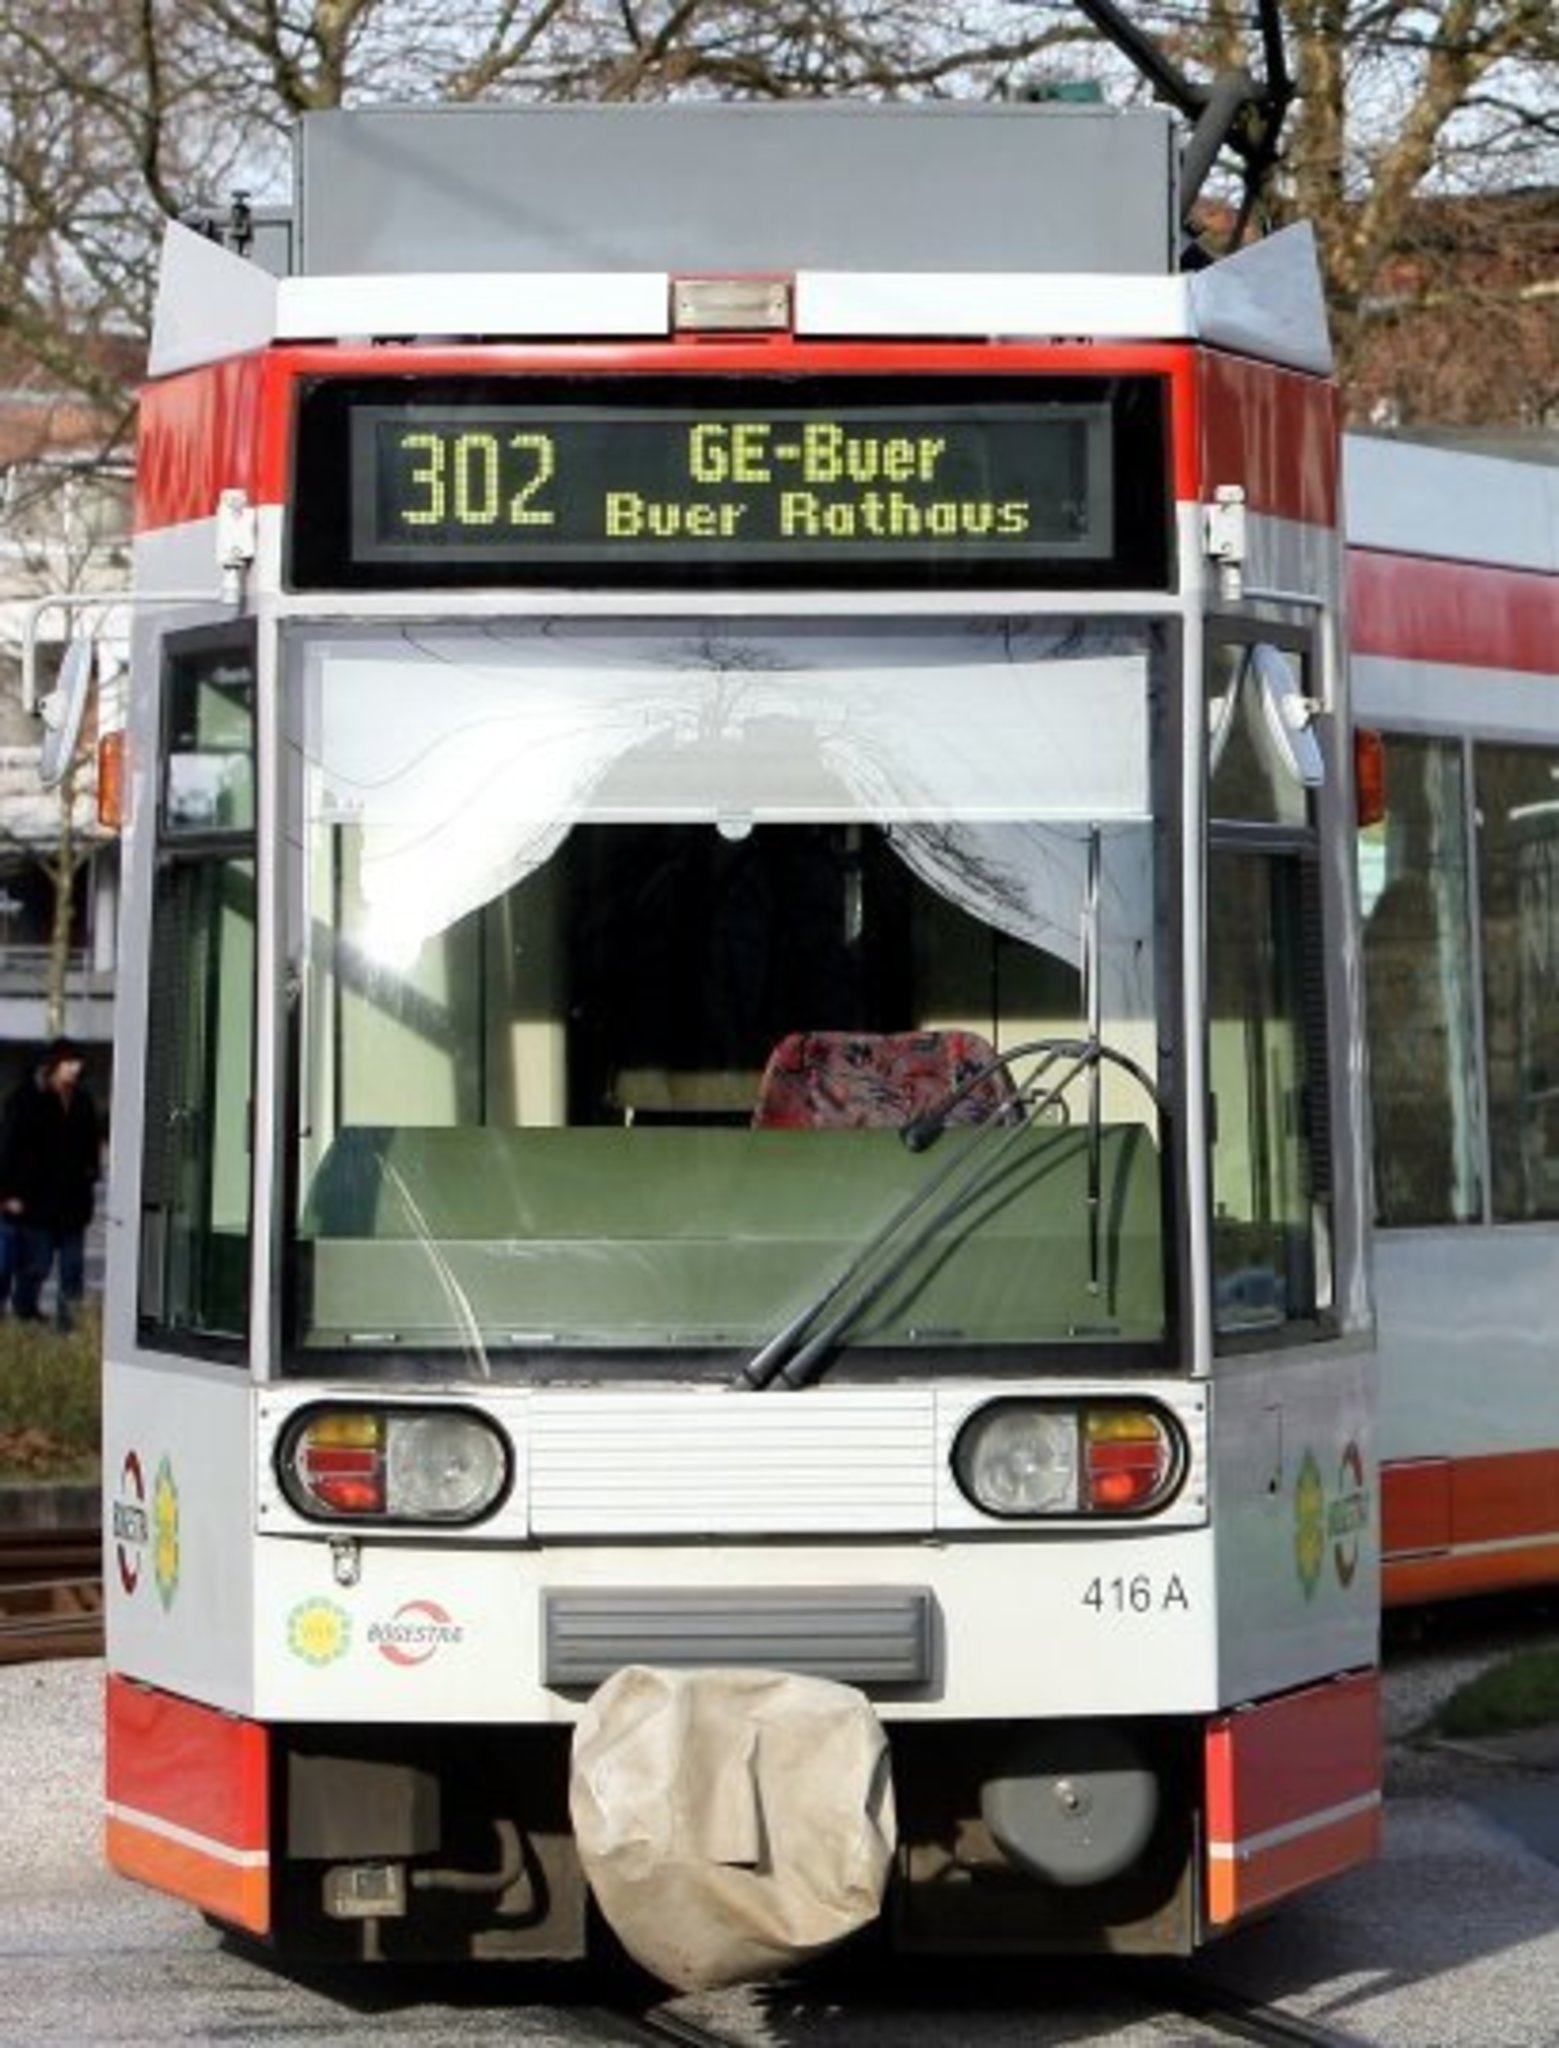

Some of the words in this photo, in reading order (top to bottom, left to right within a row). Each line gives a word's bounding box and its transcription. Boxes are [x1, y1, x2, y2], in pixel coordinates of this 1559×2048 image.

[689, 423, 946, 482] GE-Buer
[401, 433, 554, 525] 302
[605, 492, 748, 536] Buer
[779, 492, 1030, 535] Rathaus
[1081, 1574, 1151, 1613] 416
[1162, 1573, 1189, 1610] A
